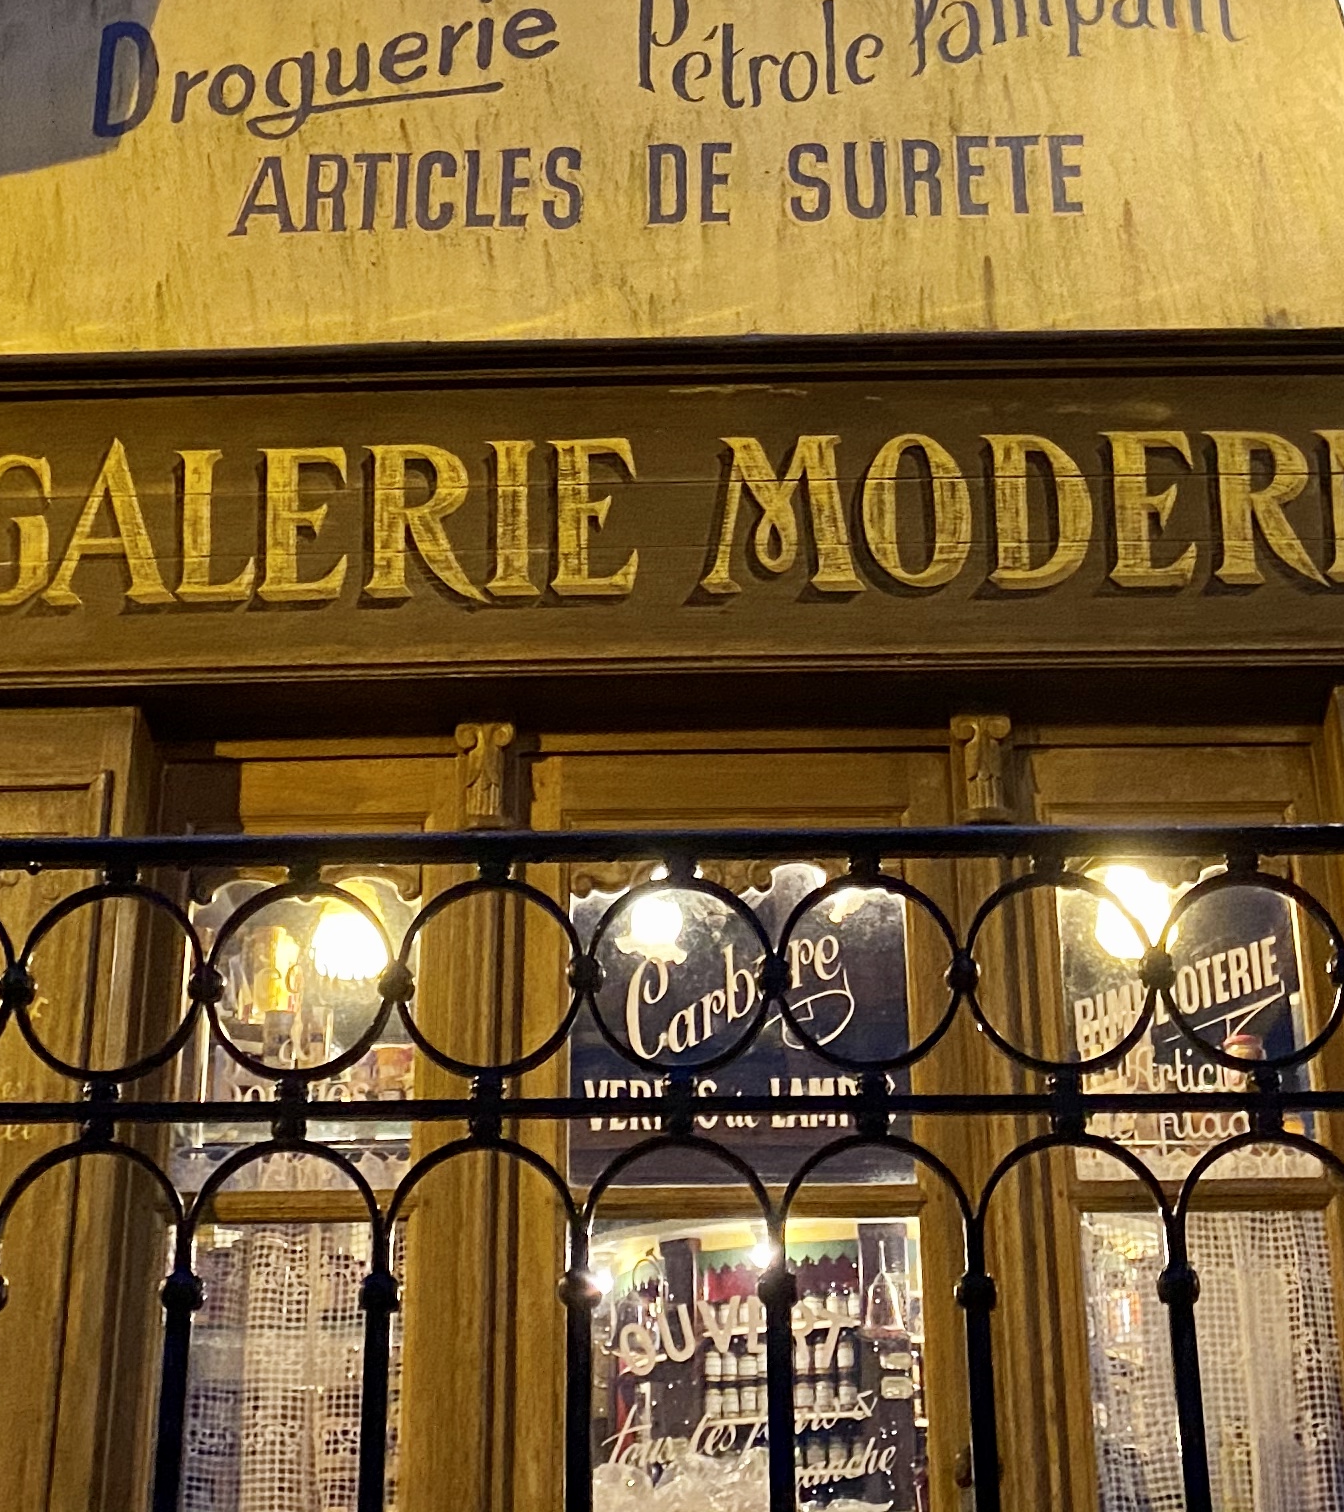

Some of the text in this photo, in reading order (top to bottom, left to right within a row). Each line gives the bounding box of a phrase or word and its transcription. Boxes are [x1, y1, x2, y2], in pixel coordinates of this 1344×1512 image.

[227, 133, 1086, 237] ARTICLES DE SURETE
[626, 934, 841, 1060] Carbre
[1074, 935, 1281, 1053] BIMLOTERIE
[584, 1078, 718, 1132] VERRS
[770, 1076, 896, 1129] LAMP
